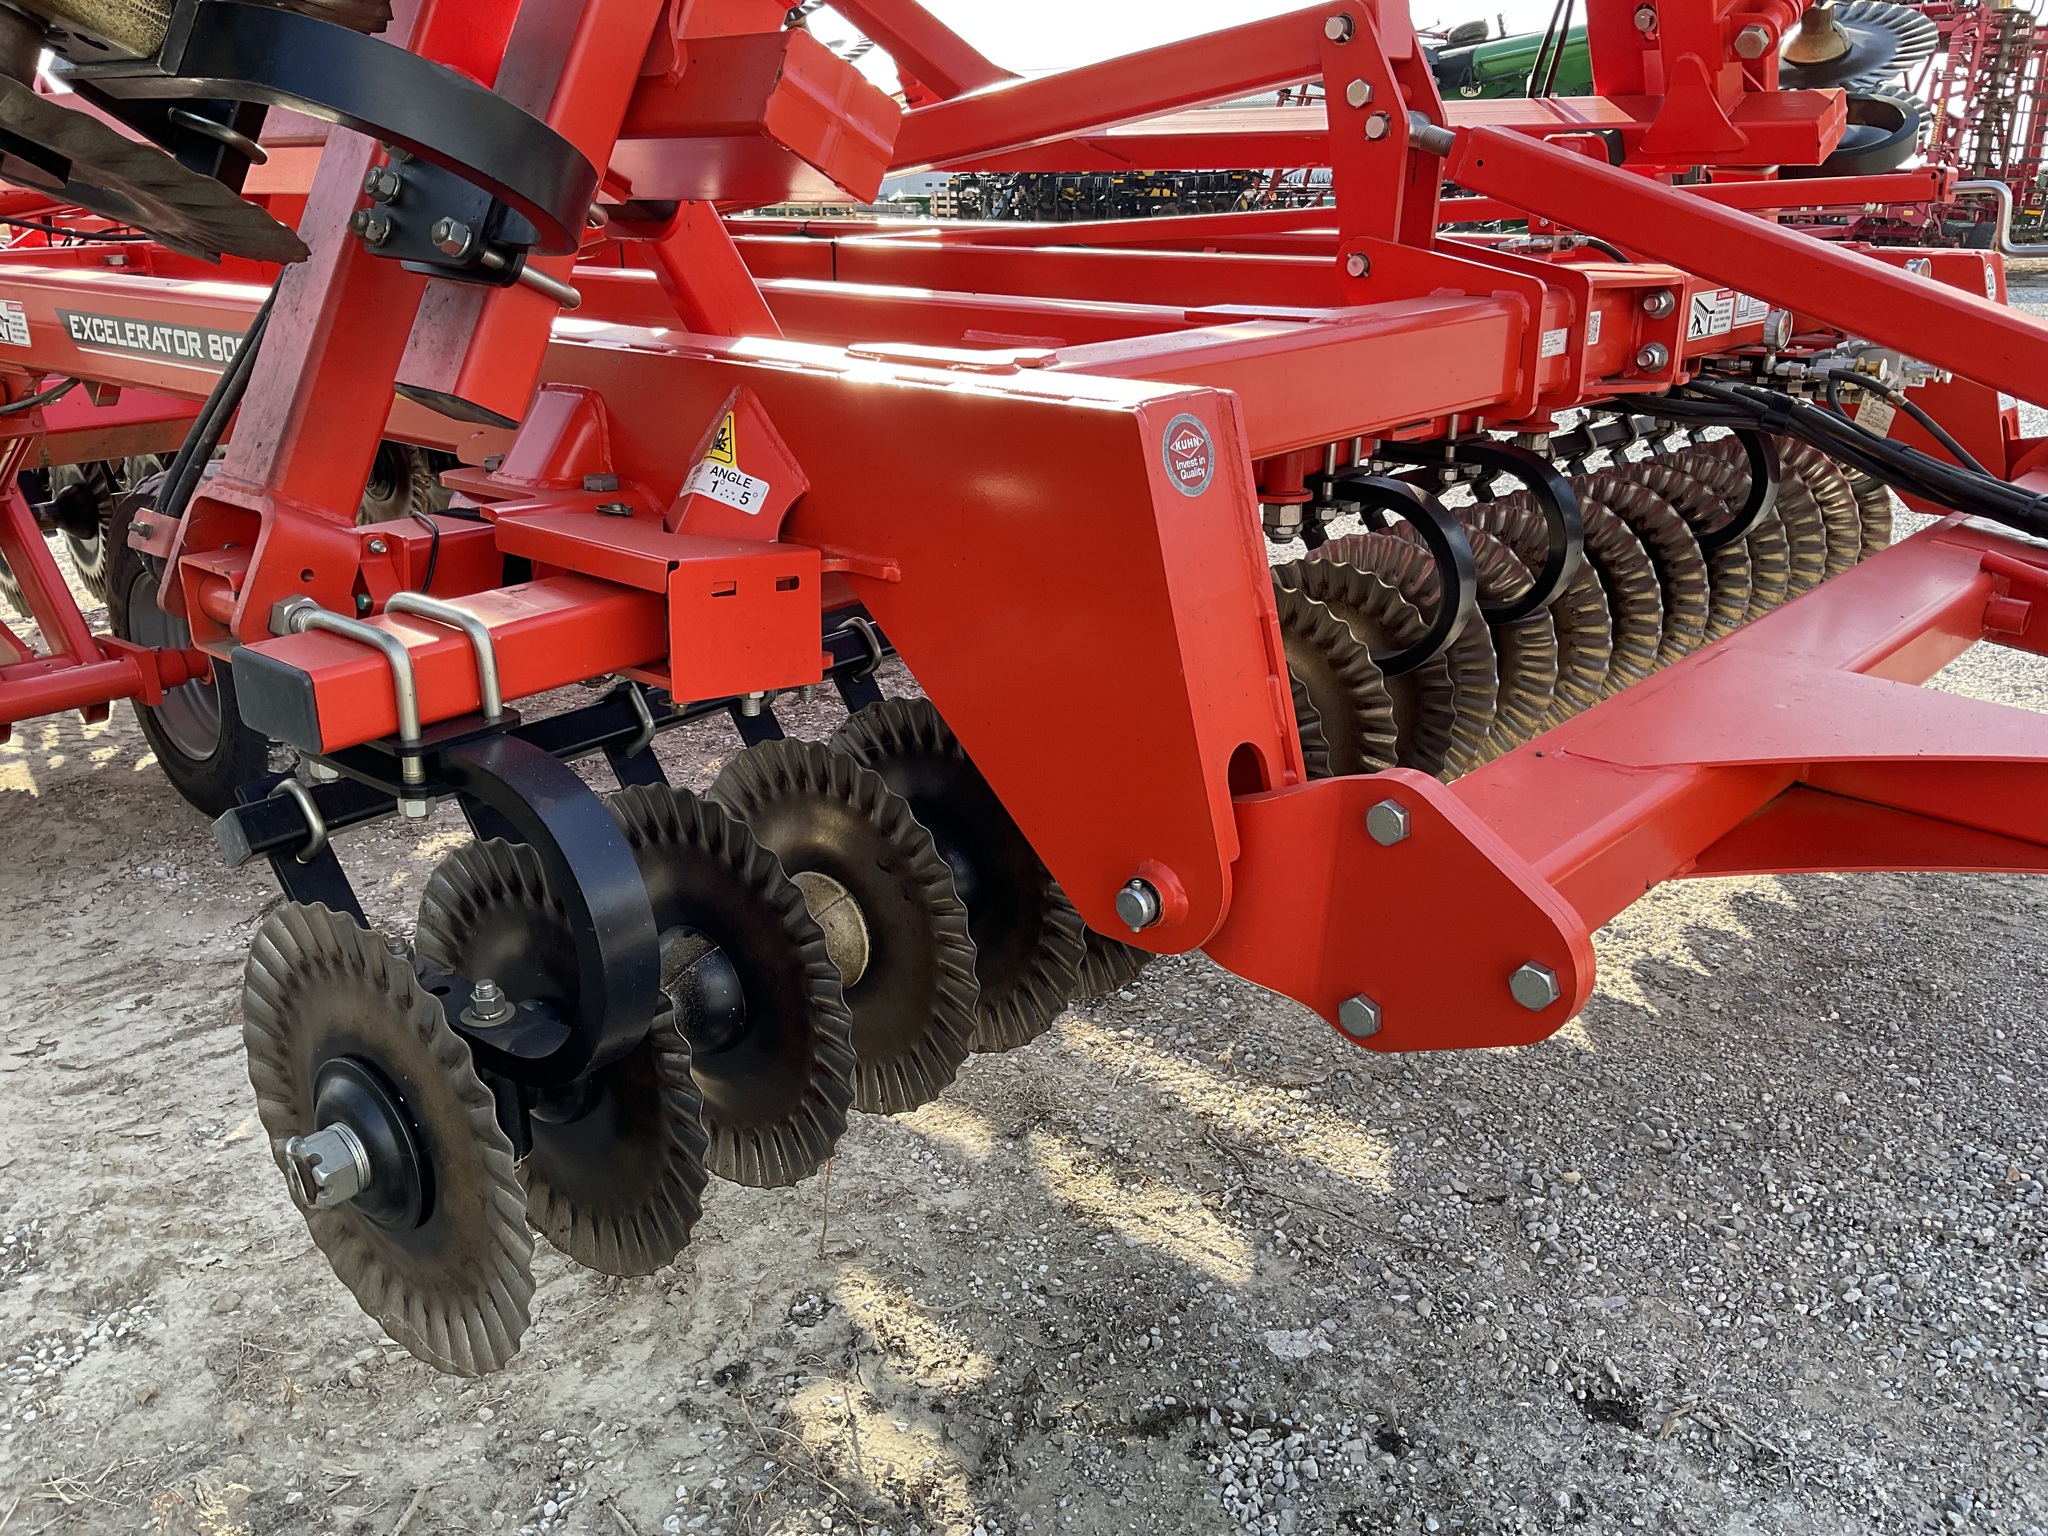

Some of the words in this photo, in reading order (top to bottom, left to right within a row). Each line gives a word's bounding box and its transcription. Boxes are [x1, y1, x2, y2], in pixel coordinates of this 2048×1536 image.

[1931, 98, 1945, 145] SUNFLOWER
[68, 314, 205, 358] EXCELERATOR
[207, 334, 244, 363] 80
[1175, 437, 1200, 451] KUHN
[1175, 457, 1198, 470] Invest
[1198, 455, 1206, 465] in
[710, 465, 753, 489] ANGLE
[1180, 466, 1206, 480] Quality
